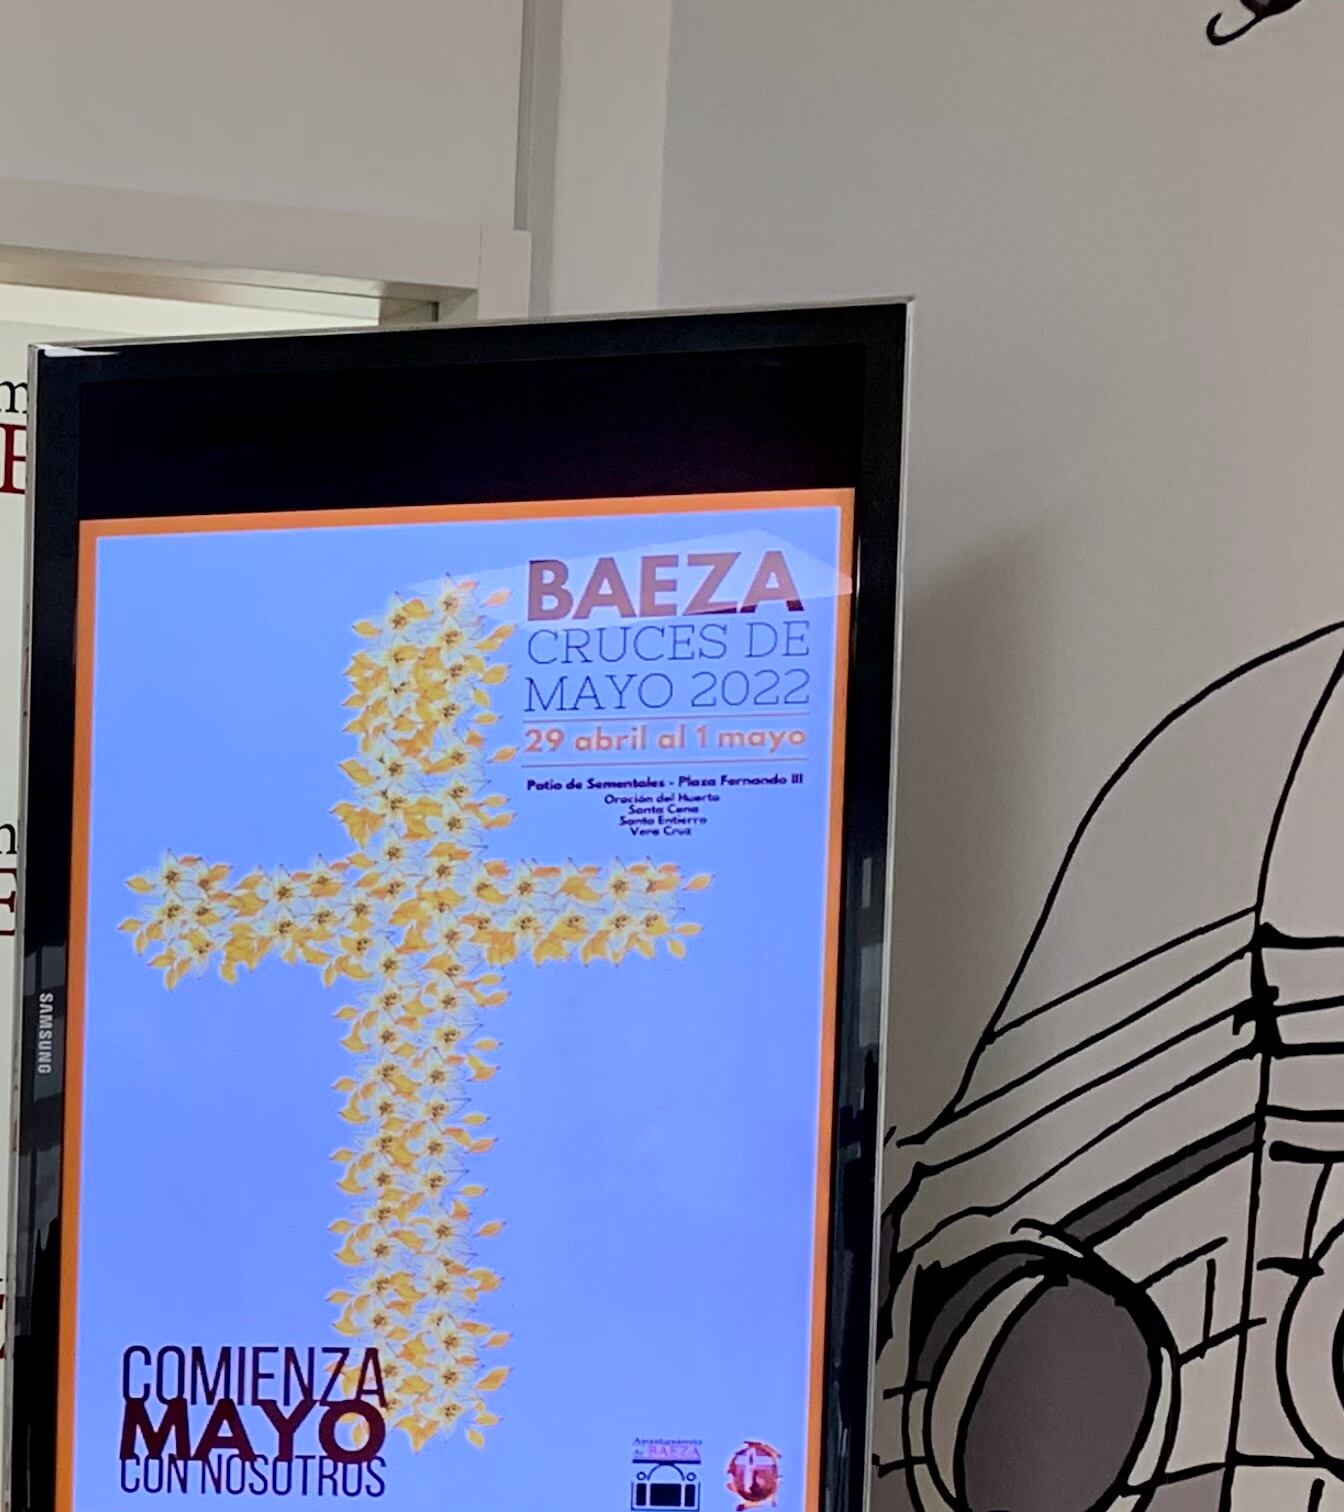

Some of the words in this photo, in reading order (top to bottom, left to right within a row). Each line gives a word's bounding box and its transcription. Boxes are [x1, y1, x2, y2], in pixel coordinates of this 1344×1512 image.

[527, 549, 805, 621] BAEZA
[527, 623, 728, 665] CRUCES
[744, 620, 811, 659] DE
[523, 672, 674, 713] MAYO
[690, 667, 811, 708] 2022
[524, 727, 565, 752] 29
[574, 726, 647, 751] abril
[657, 725, 686, 750] al
[696, 725, 708, 749] 1
[718, 727, 806, 754] mayo
[526, 779, 562, 791] Patio
[565, 777, 584, 790] de
[587, 777, 665, 790] Sementales
[678, 775, 717, 788] Plaza
[720, 774, 787, 787] Fernando
[790, 773, 804, 785] III
[656, 792, 675, 804] del
[37, 992, 54, 1074] SAMSUNG
[123, 1345, 388, 1407] COMIENZA
[119, 1397, 386, 1463] MAYO
[120, 1453, 189, 1494] CON
[200, 1453, 387, 1498] NOSOTROS
